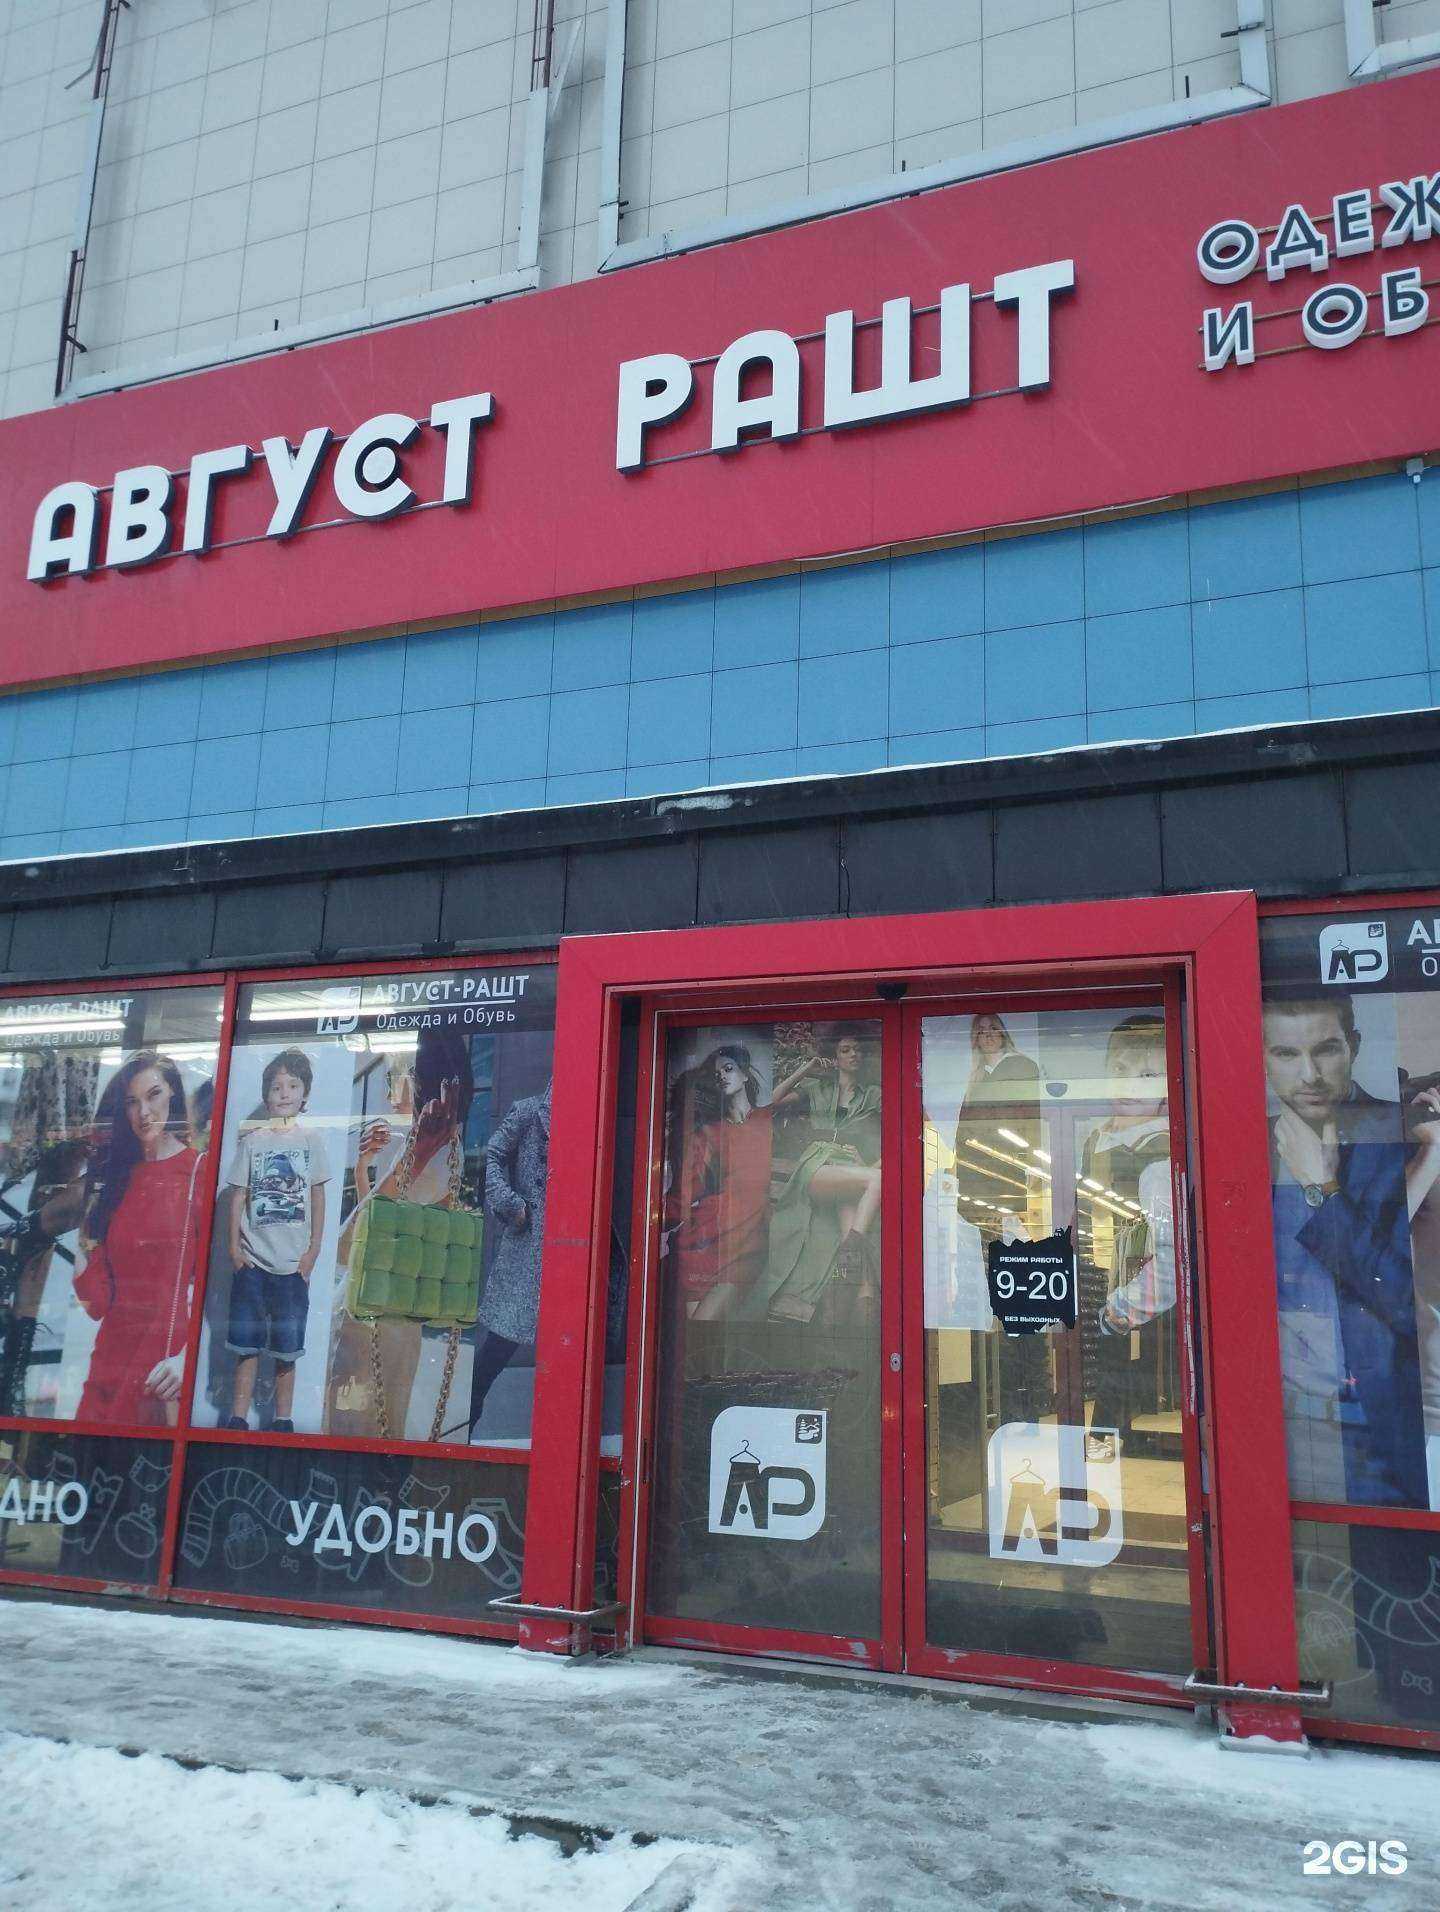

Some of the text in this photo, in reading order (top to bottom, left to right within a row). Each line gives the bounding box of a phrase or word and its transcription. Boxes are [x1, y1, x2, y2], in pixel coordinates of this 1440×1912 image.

[1197, 171, 1440, 284] ОДЕЖ
[1203, 266, 1429, 371] И ОБ
[27, 259, 1077, 582] АВГУСТ РАШТ
[373, 975, 530, 1003] АВГУСТ-РАШТ
[376, 1007, 516, 1031] Одежда и Обувь
[999, 1256, 1064, 1264] РЕЖИМ РАБОТЫ
[996, 1270, 1068, 1301] 9-20
[1004, 1315, 1061, 1324] БЕЗ ВЫХОДНЫХ
[285, 1500, 498, 1564] УДОБНО
